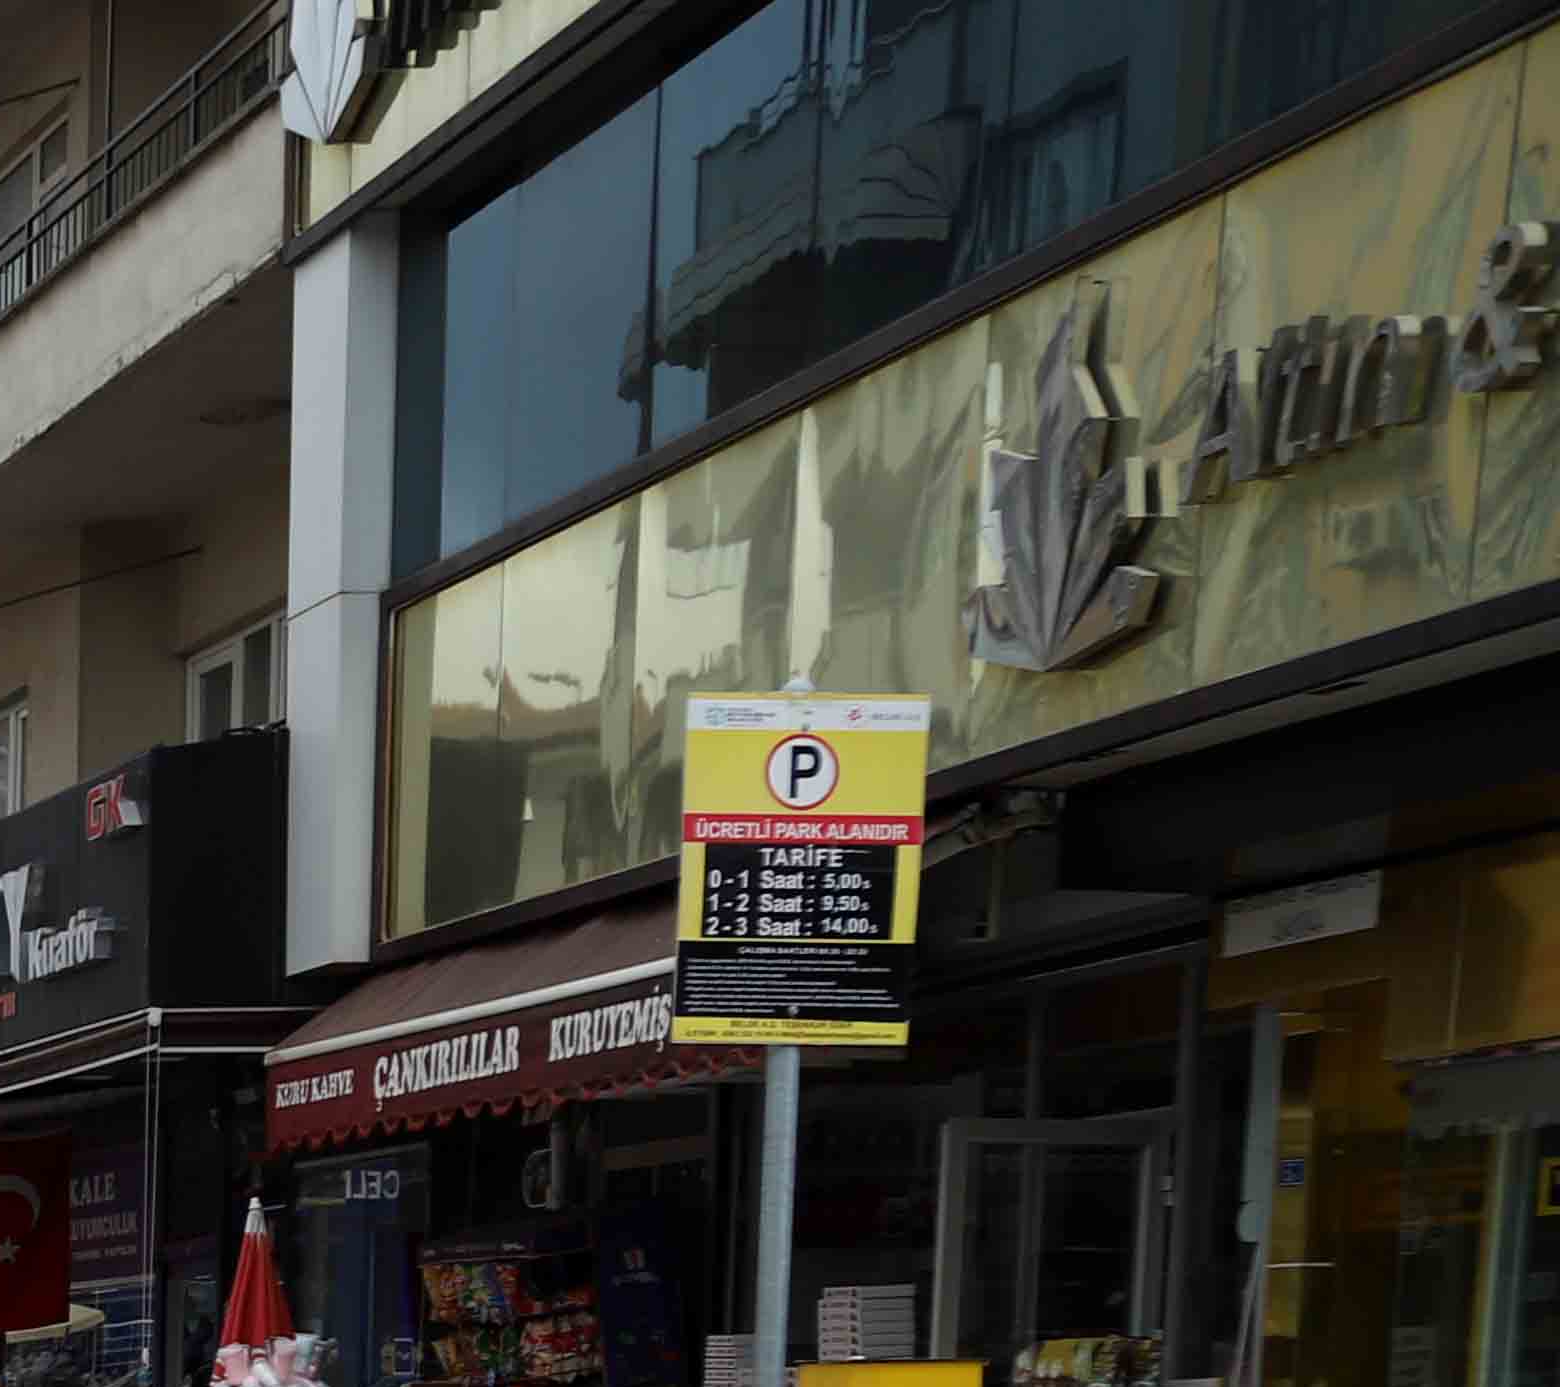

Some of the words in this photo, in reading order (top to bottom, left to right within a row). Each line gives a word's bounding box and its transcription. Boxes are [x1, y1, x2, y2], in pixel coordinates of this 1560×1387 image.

[787, 745, 822, 798] P
[695, 817, 771, 839] ÜCRETLİ
[774, 821, 825, 840] PARK
[828, 824, 910, 841] ALANIDIR
[760, 846, 844, 868] TARİFE
[548, 985, 673, 1063] KURUYEMİŞ
[274, 1083, 310, 1109] KURU
[310, 1068, 355, 1104] KAHVE
[372, 1025, 520, 1111] ÇANKIRILILAR
